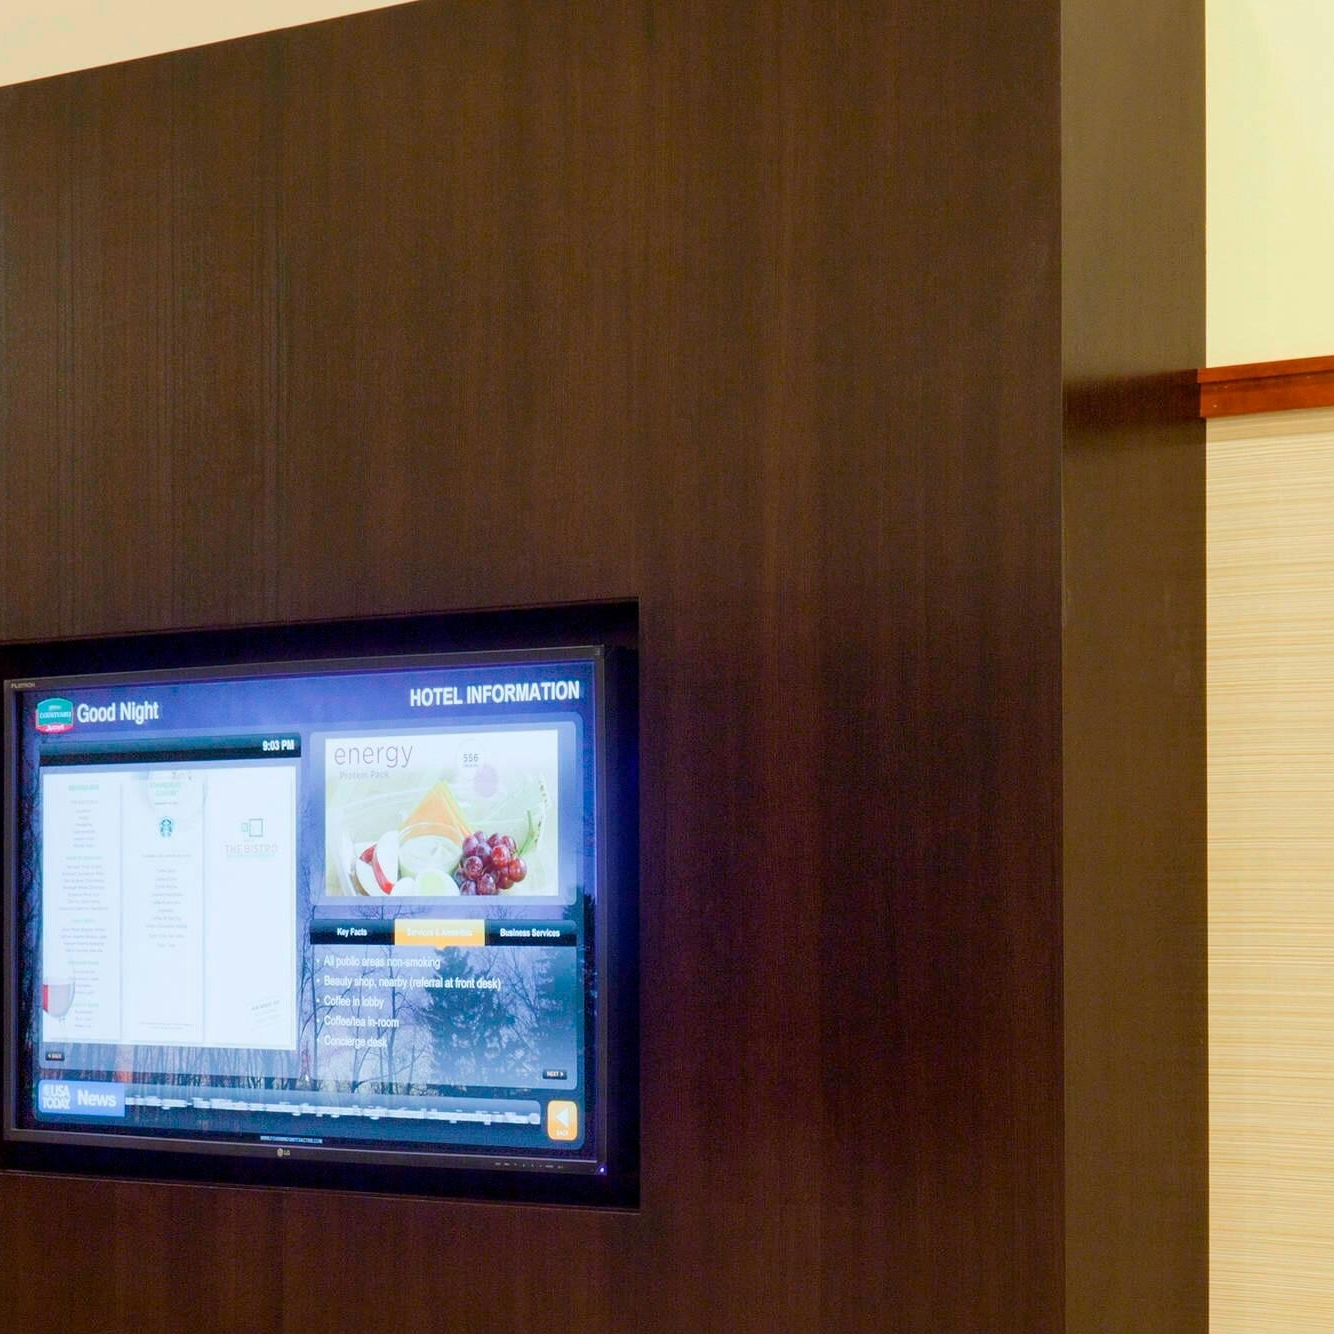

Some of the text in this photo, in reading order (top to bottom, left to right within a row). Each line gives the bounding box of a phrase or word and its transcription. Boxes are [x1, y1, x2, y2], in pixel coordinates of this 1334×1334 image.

[410, 680, 580, 707] HOTEL INFORMATION
[77, 701, 160, 725] Good Night
[262, 739, 295, 751] 9:03 PM
[334, 745, 413, 768] energy
[339, 769, 390, 779] Protein Pack
[336, 927, 368, 938] Key Facts
[500, 928, 561, 937] Business Services
[324, 955, 441, 969] All public areas non-smoking
[324, 975, 501, 991] Beauty shop, nearby (referral at front desk)
[324, 995, 384, 1009] Coffee in lobby
[324, 1015, 400, 1028] Coffee/tea in-room
[324, 1035, 387, 1049] Concierge desk
[50, 1084, 70, 1097] USA
[77, 1089, 117, 1107] News
